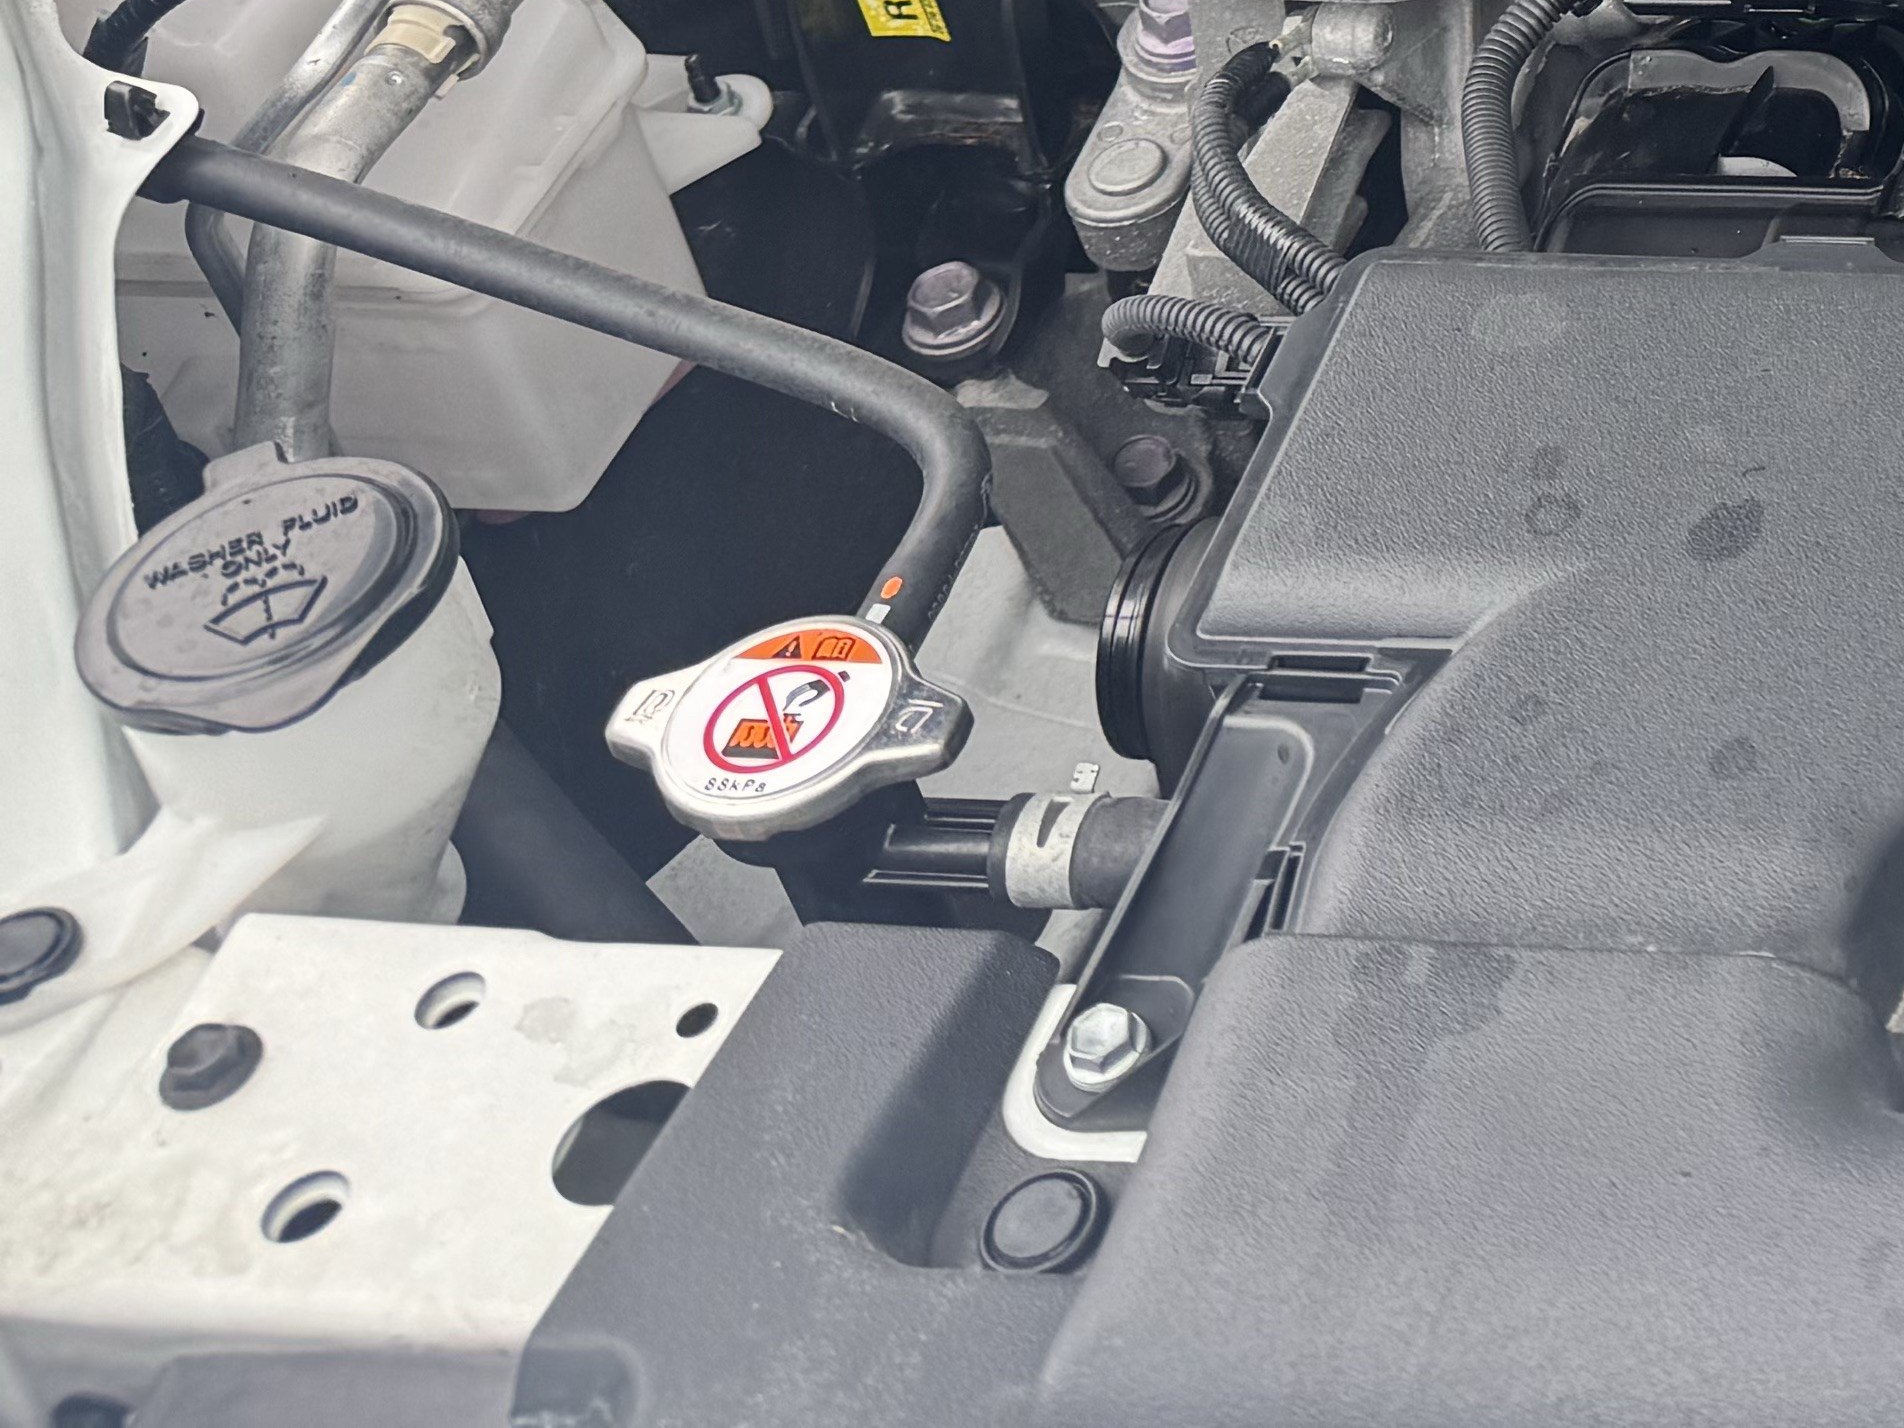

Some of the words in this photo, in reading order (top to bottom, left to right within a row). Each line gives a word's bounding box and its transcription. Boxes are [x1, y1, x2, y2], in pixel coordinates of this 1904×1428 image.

[143, 529, 263, 591] WASHER
[281, 494, 358, 536] FLUID
[220, 537, 290, 578] ONLY
